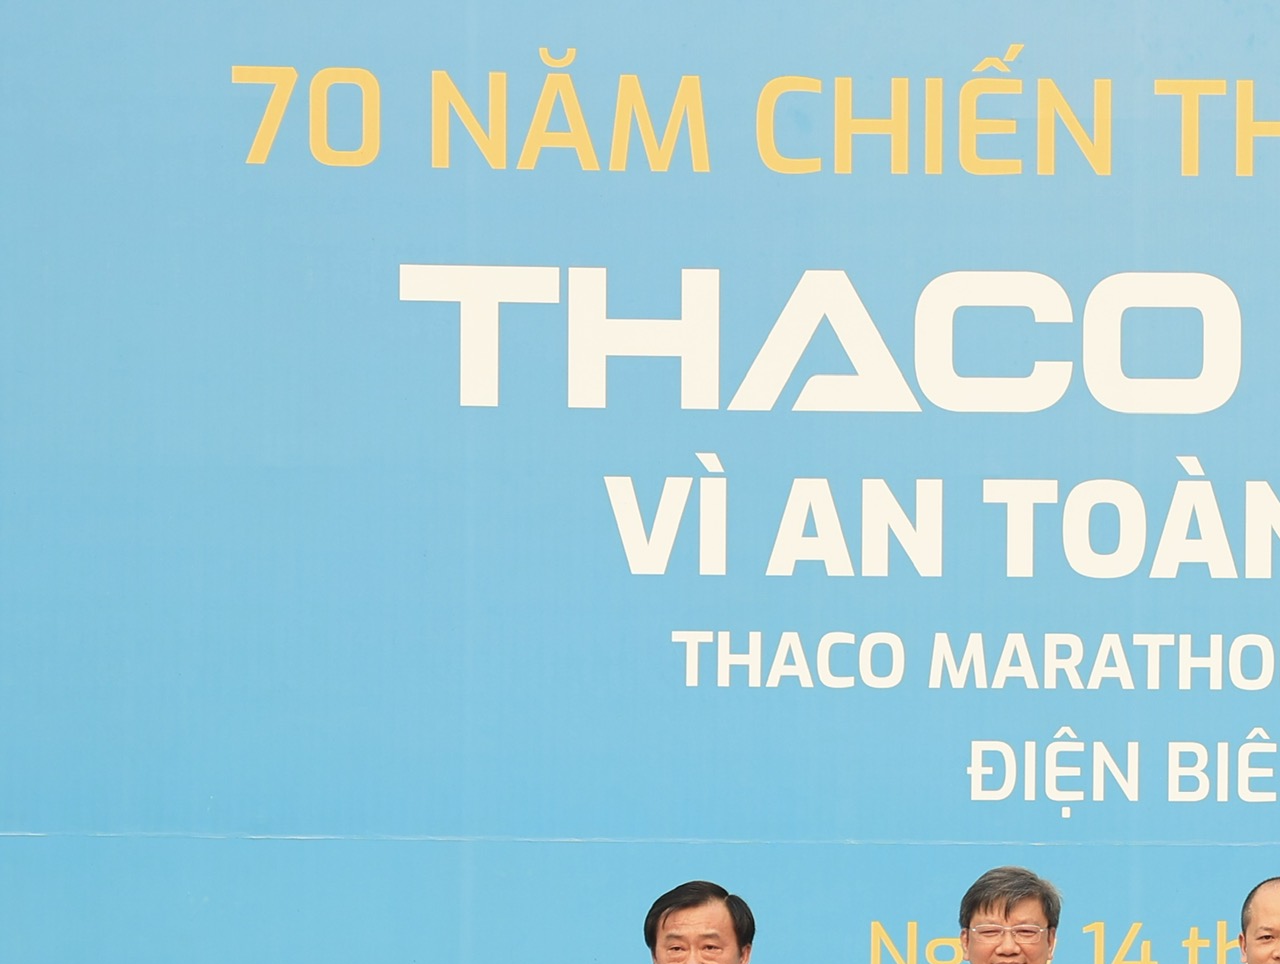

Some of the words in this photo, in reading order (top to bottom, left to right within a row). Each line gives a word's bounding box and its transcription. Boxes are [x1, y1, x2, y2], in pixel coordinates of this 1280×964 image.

[230, 65, 384, 170] 70
[430, 47, 714, 175] NĂM
[755, 43, 1116, 179] CHIẾN
[399, 263, 1244, 416] THACO
[605, 453, 730, 577] VÌ
[766, 477, 946, 579] AN
[672, 631, 908, 690] THACO
[967, 727, 1142, 820] ĐIỆN
